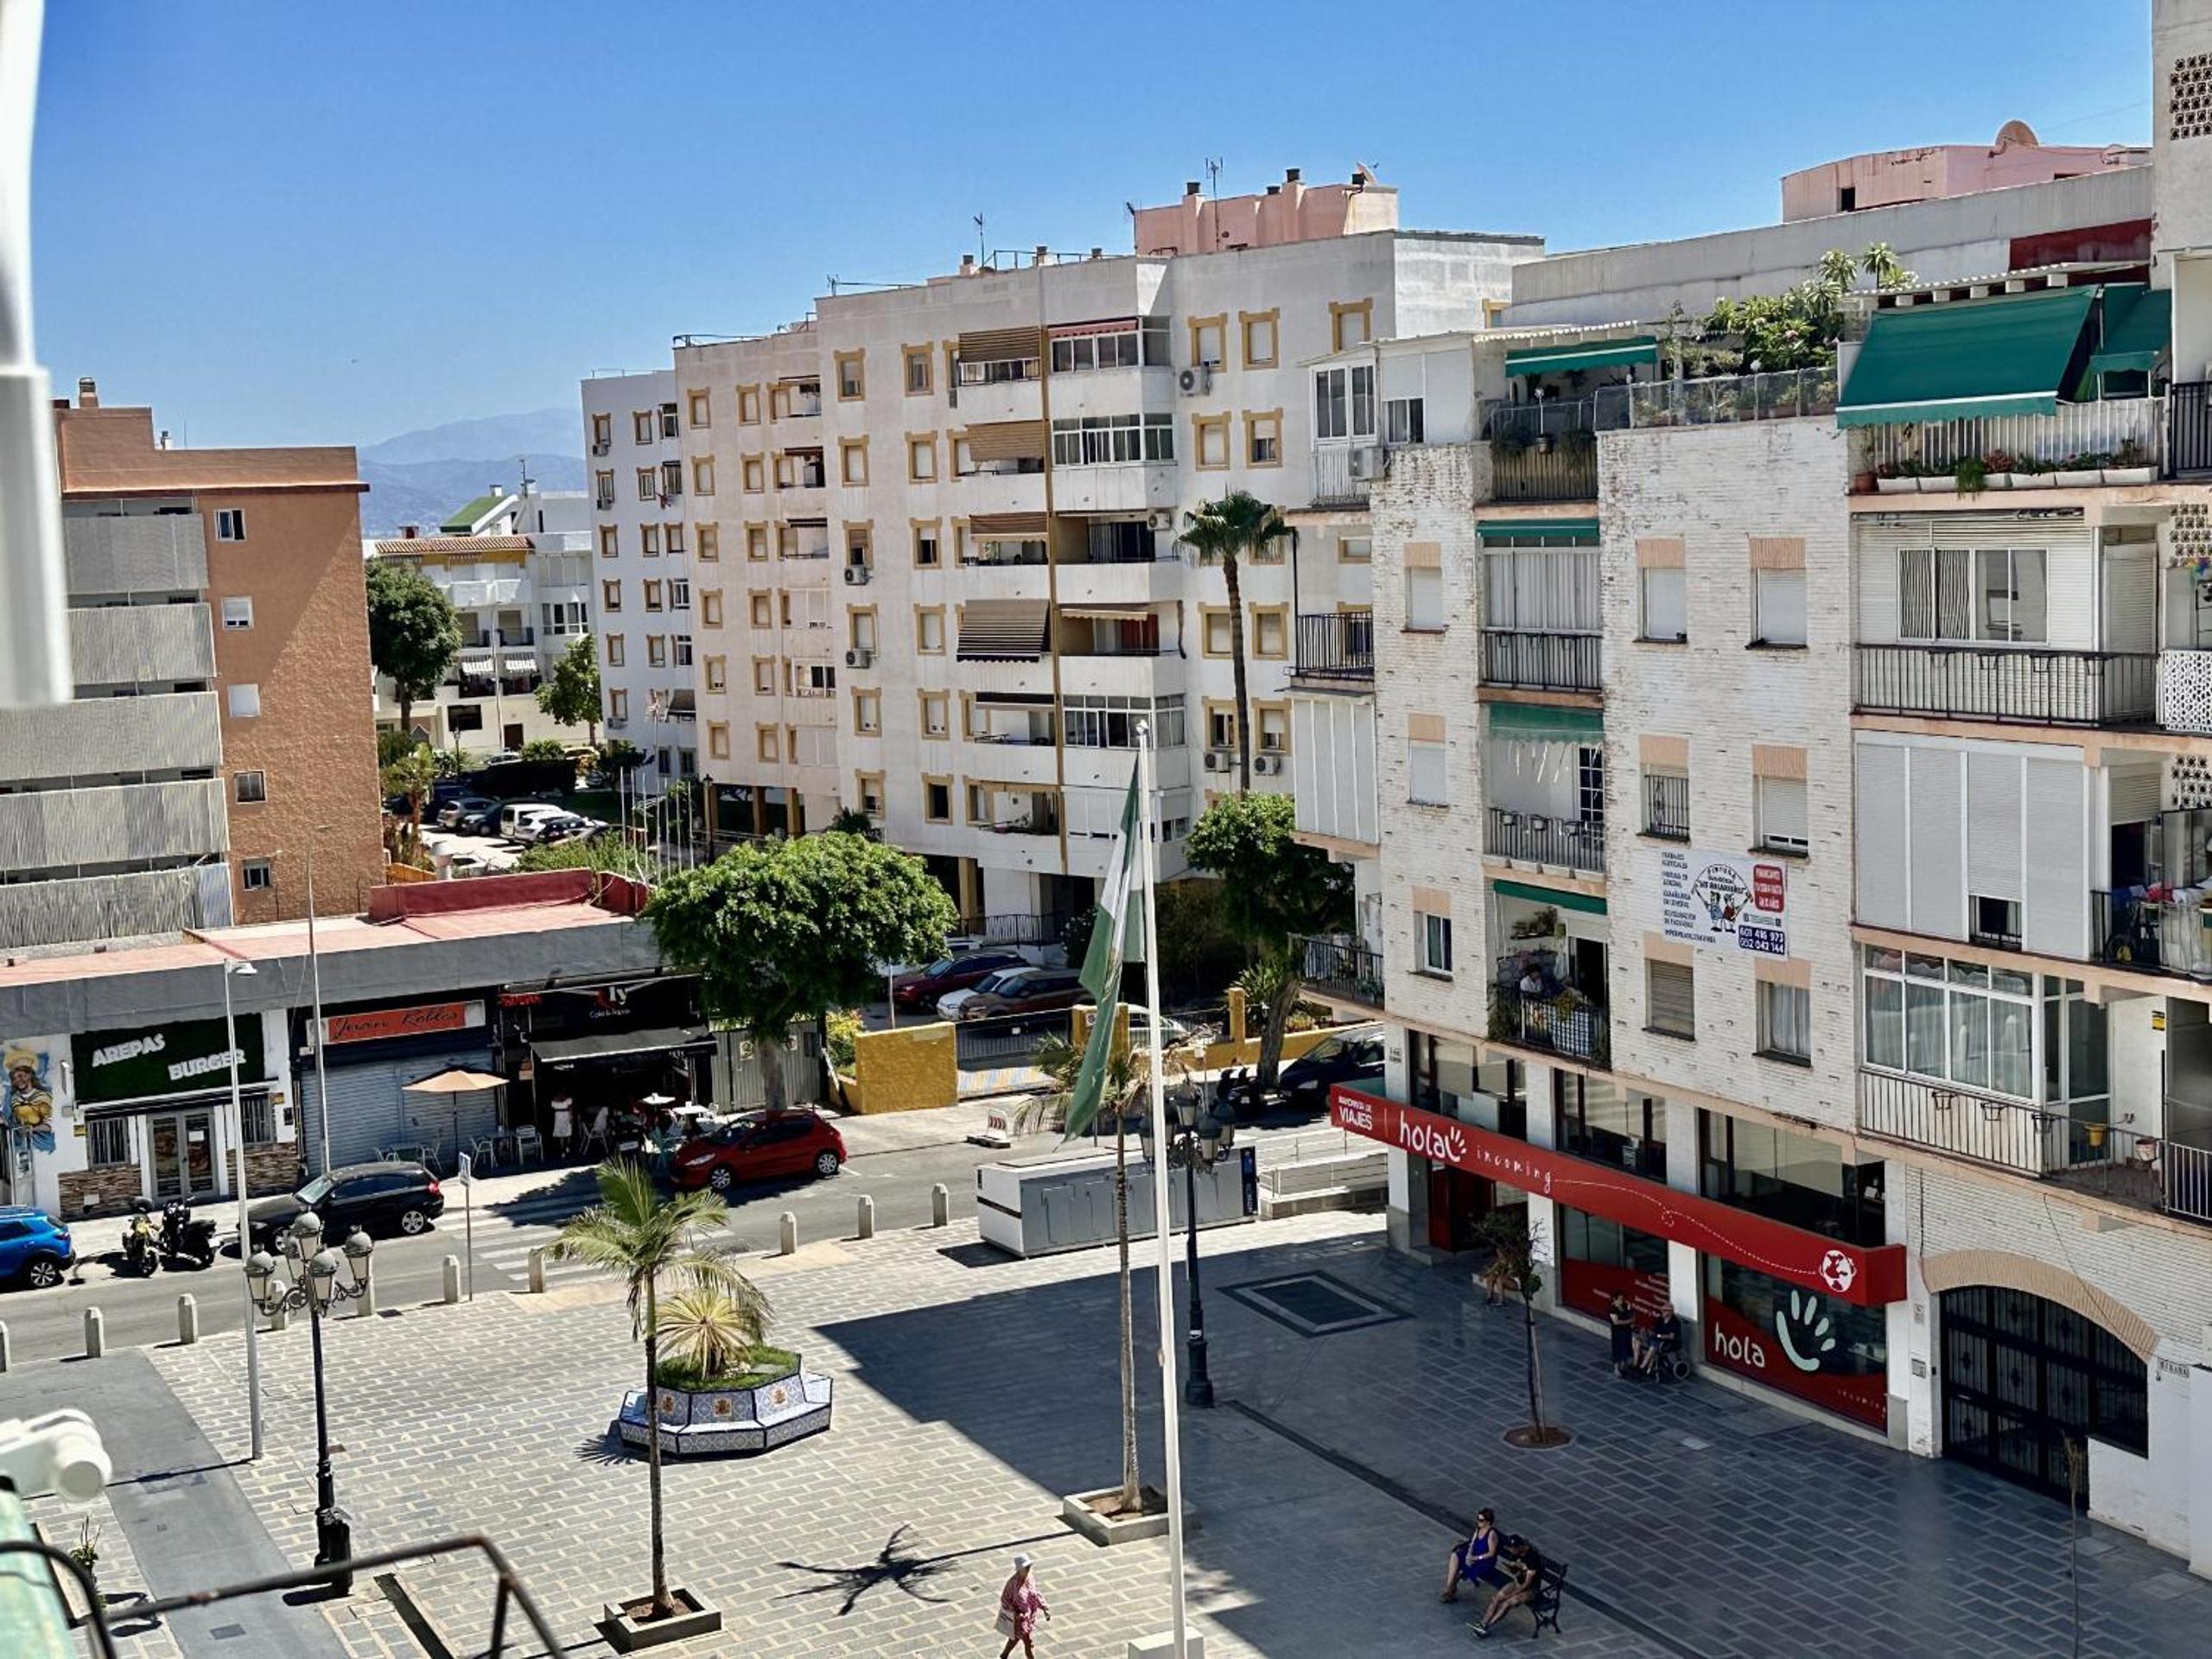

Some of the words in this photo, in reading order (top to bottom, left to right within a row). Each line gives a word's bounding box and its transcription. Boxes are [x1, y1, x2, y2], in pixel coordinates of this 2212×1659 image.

[92, 1033, 166, 1069] AREPAS
[168, 1048, 247, 1081] BURGER
[1338, 1105, 1373, 1131] VIAJES
[1400, 1110, 1446, 1160] hola
[1476, 1146, 1552, 1193] incoming
[1714, 1321, 1766, 1369] hola
